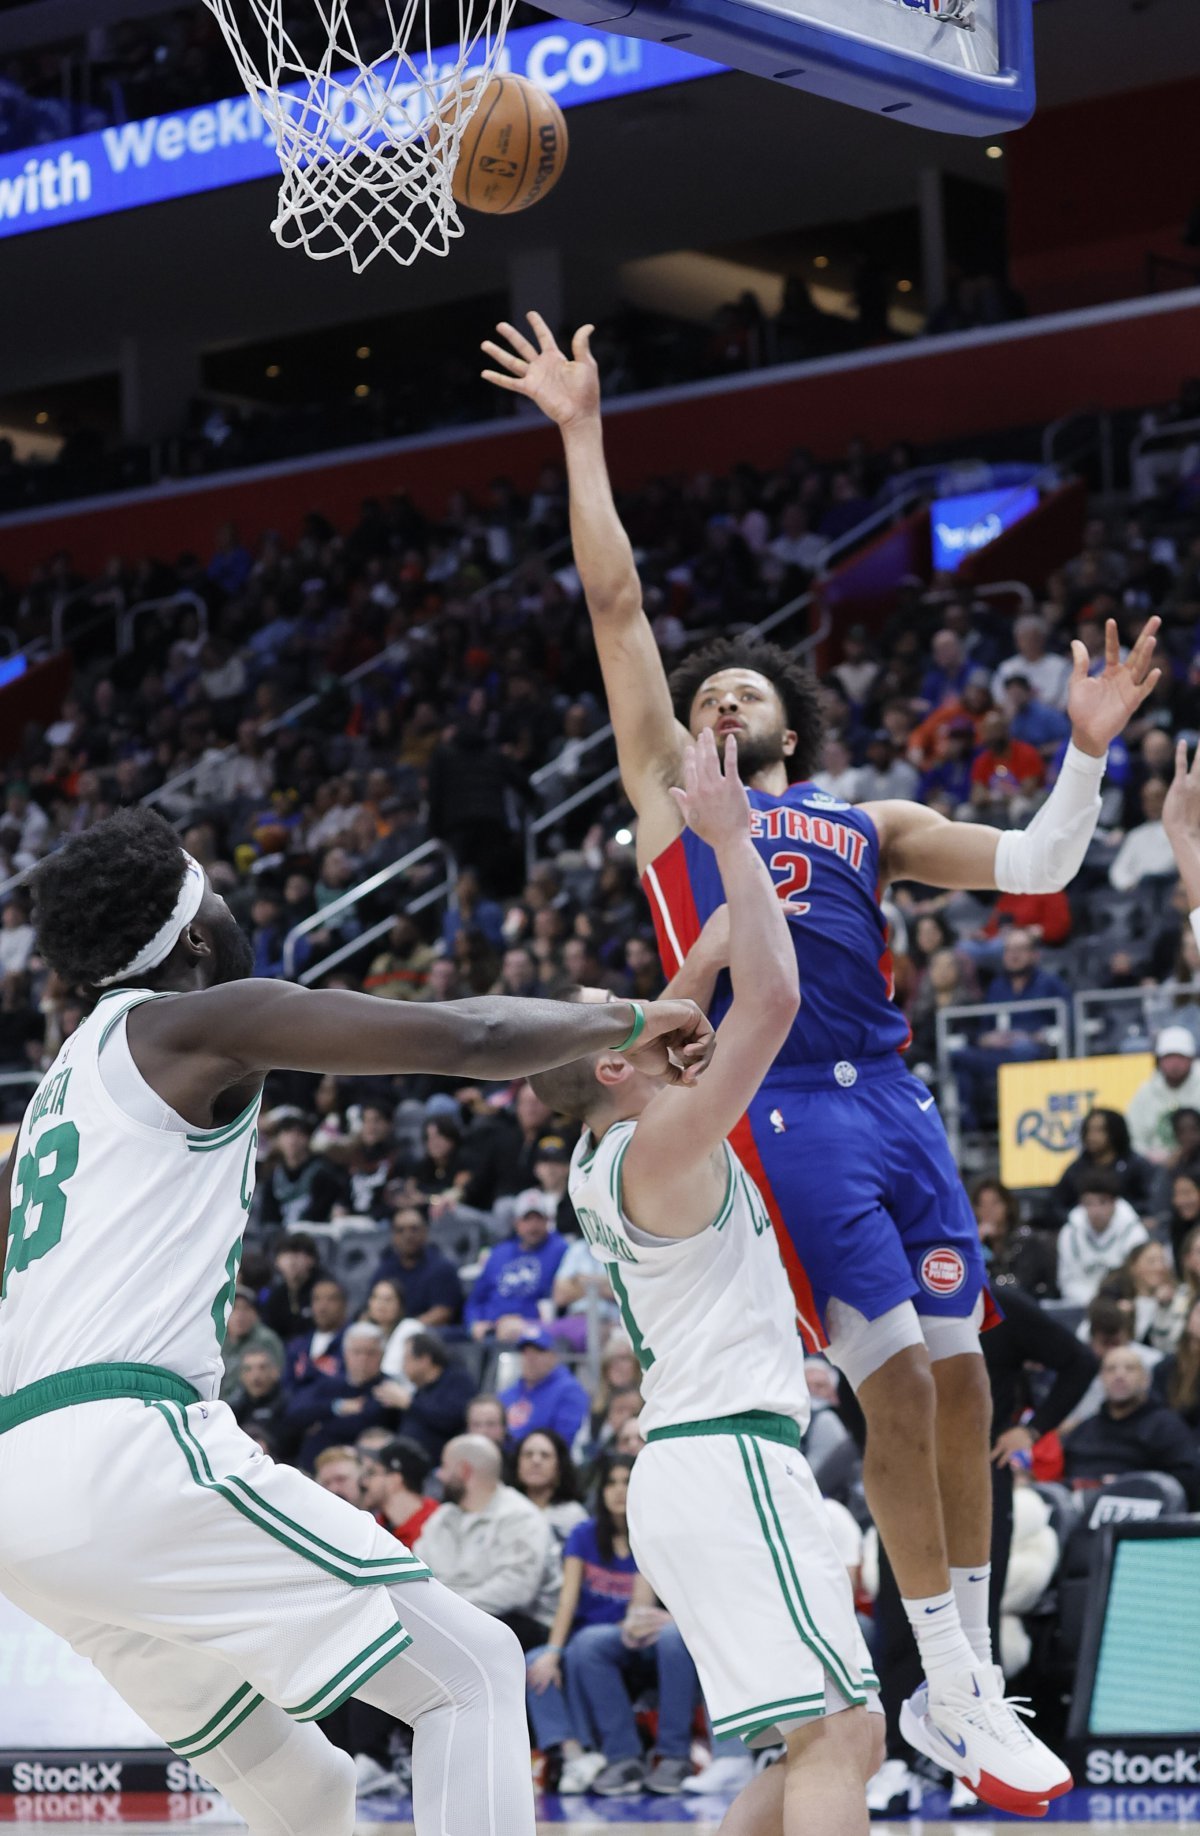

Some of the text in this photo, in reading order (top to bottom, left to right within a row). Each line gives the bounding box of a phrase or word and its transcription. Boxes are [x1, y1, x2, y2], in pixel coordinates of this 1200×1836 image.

[0, 151, 91, 220] with
[103, 90, 296, 173] Weekly
[749, 806, 868, 872] ETROIT
[13, 1761, 123, 1792] StockX
[1086, 1748, 1200, 1785] Stock
